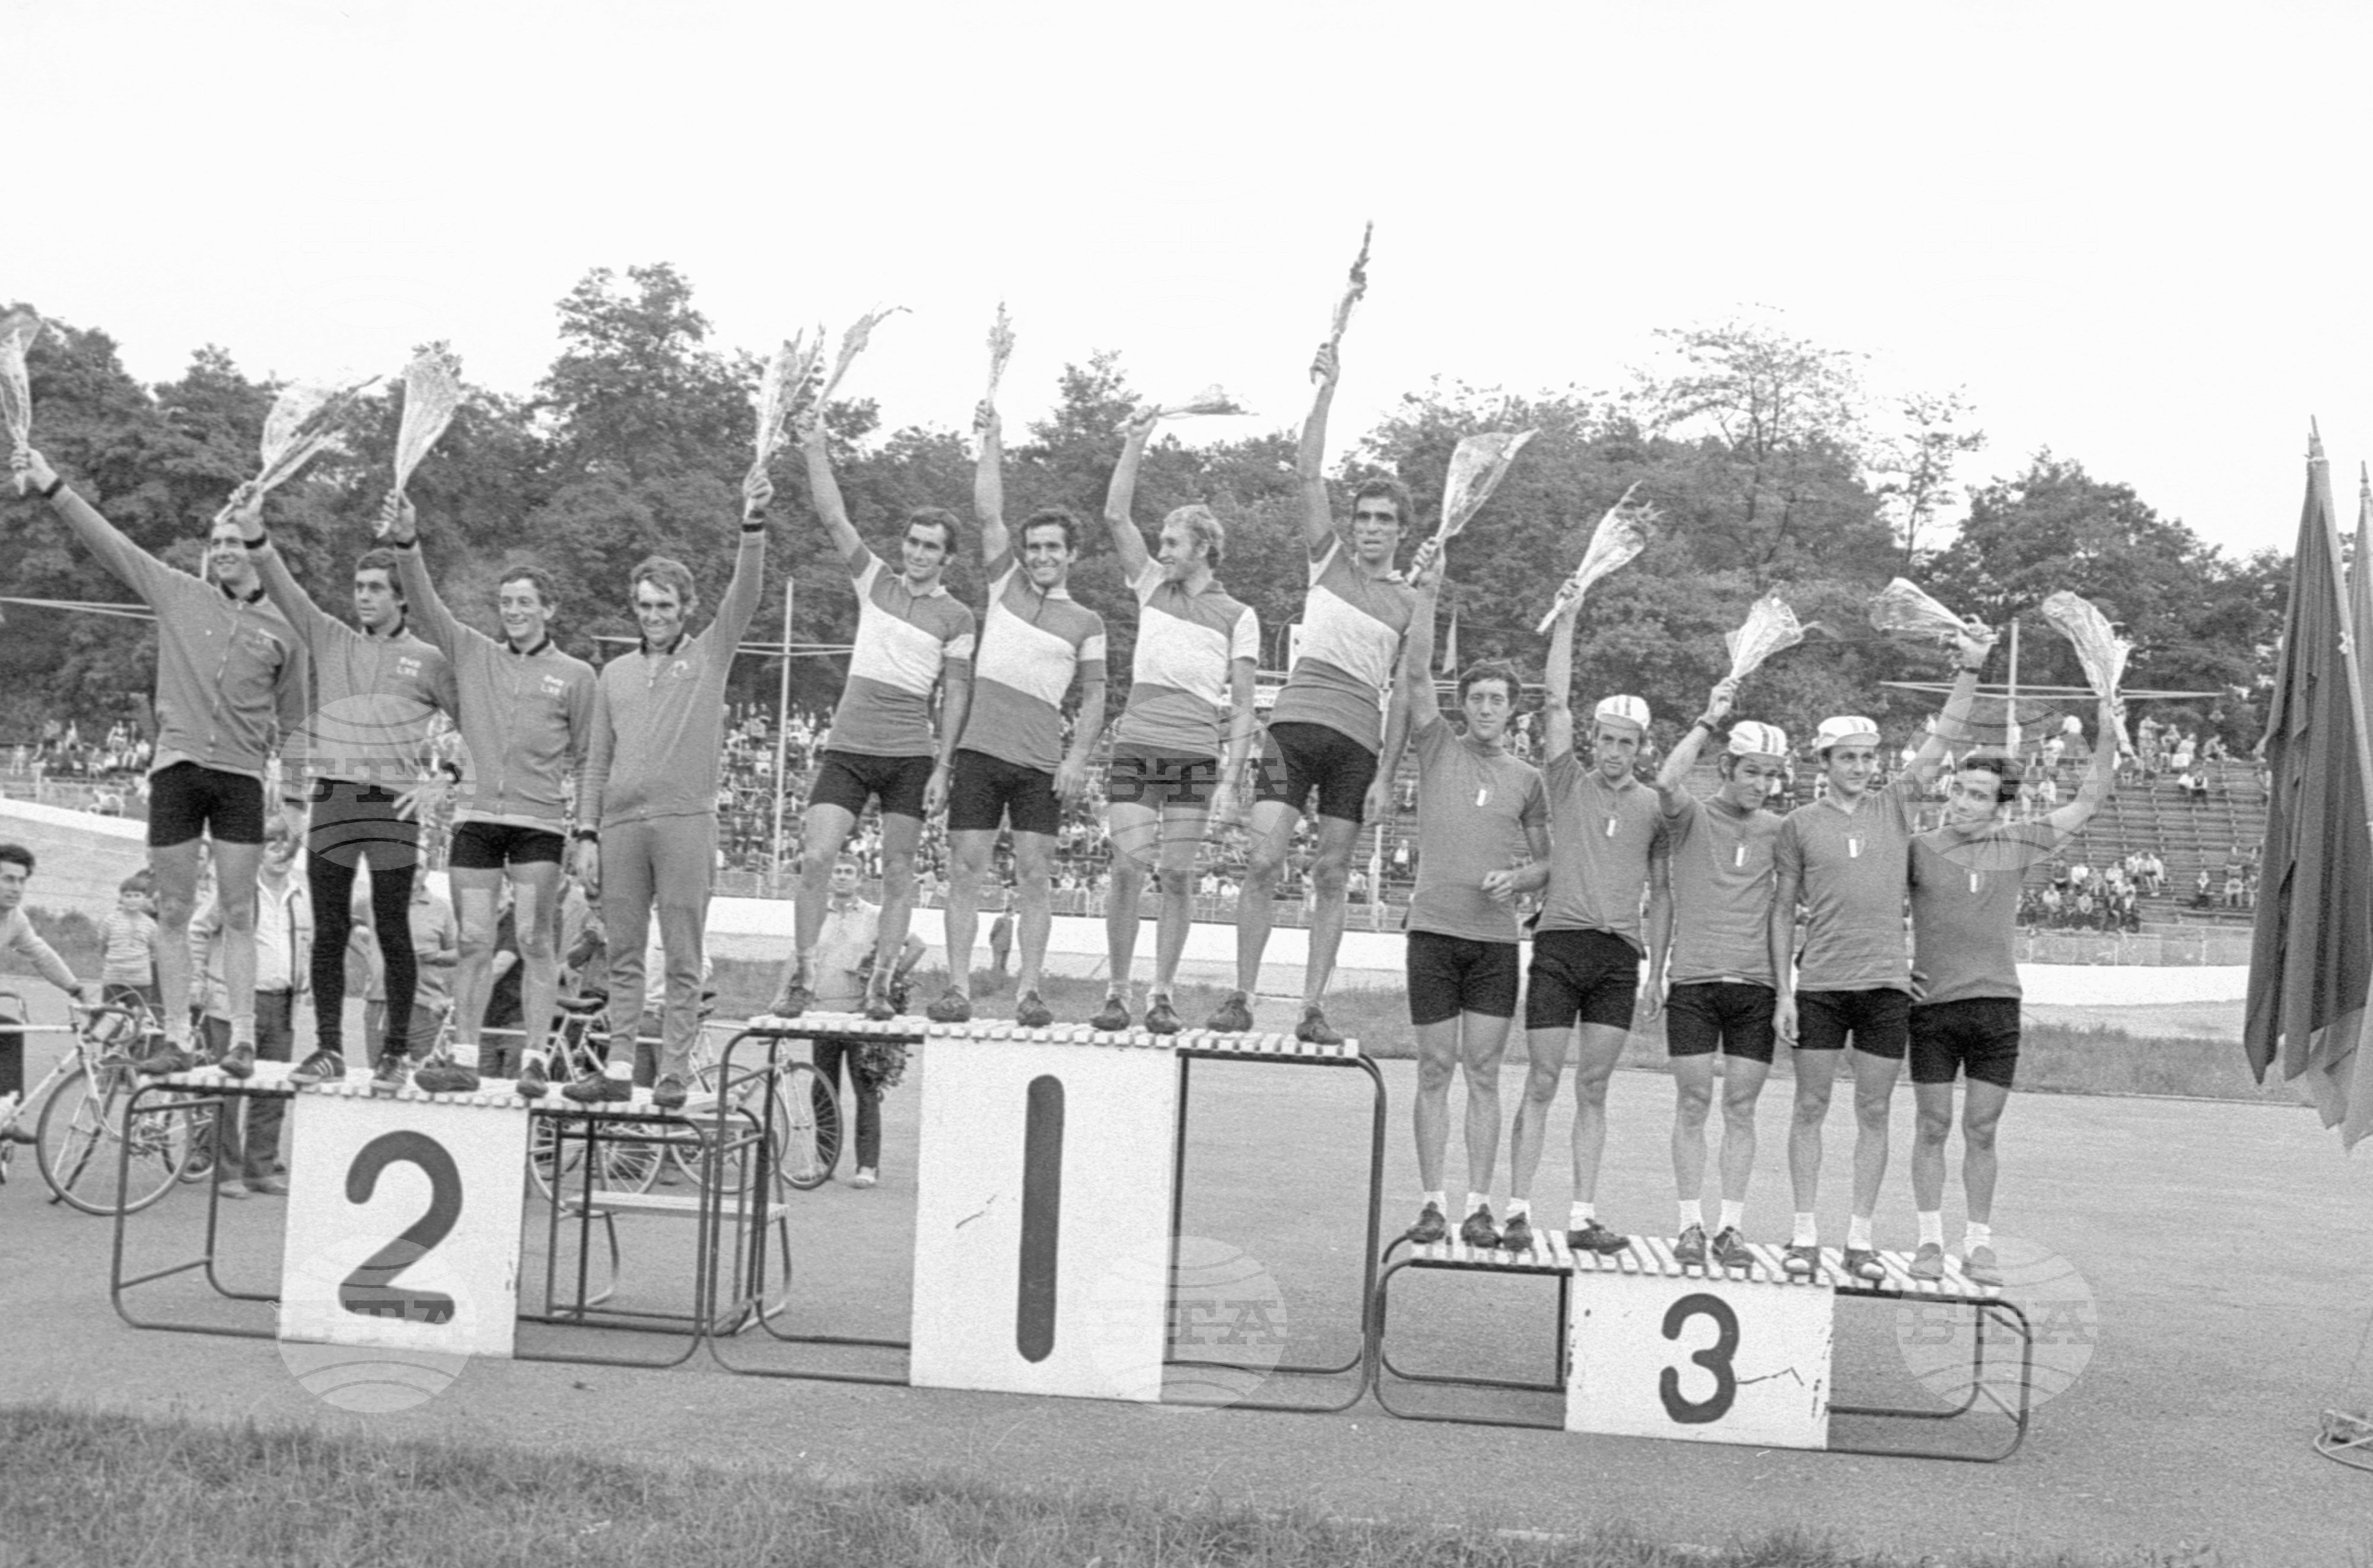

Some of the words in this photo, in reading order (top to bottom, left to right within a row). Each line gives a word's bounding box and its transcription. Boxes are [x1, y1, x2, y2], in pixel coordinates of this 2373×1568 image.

[338, 1130, 463, 1325] 2
[1017, 1075, 1064, 1363] 1
[1659, 1293, 1739, 1424] 3
